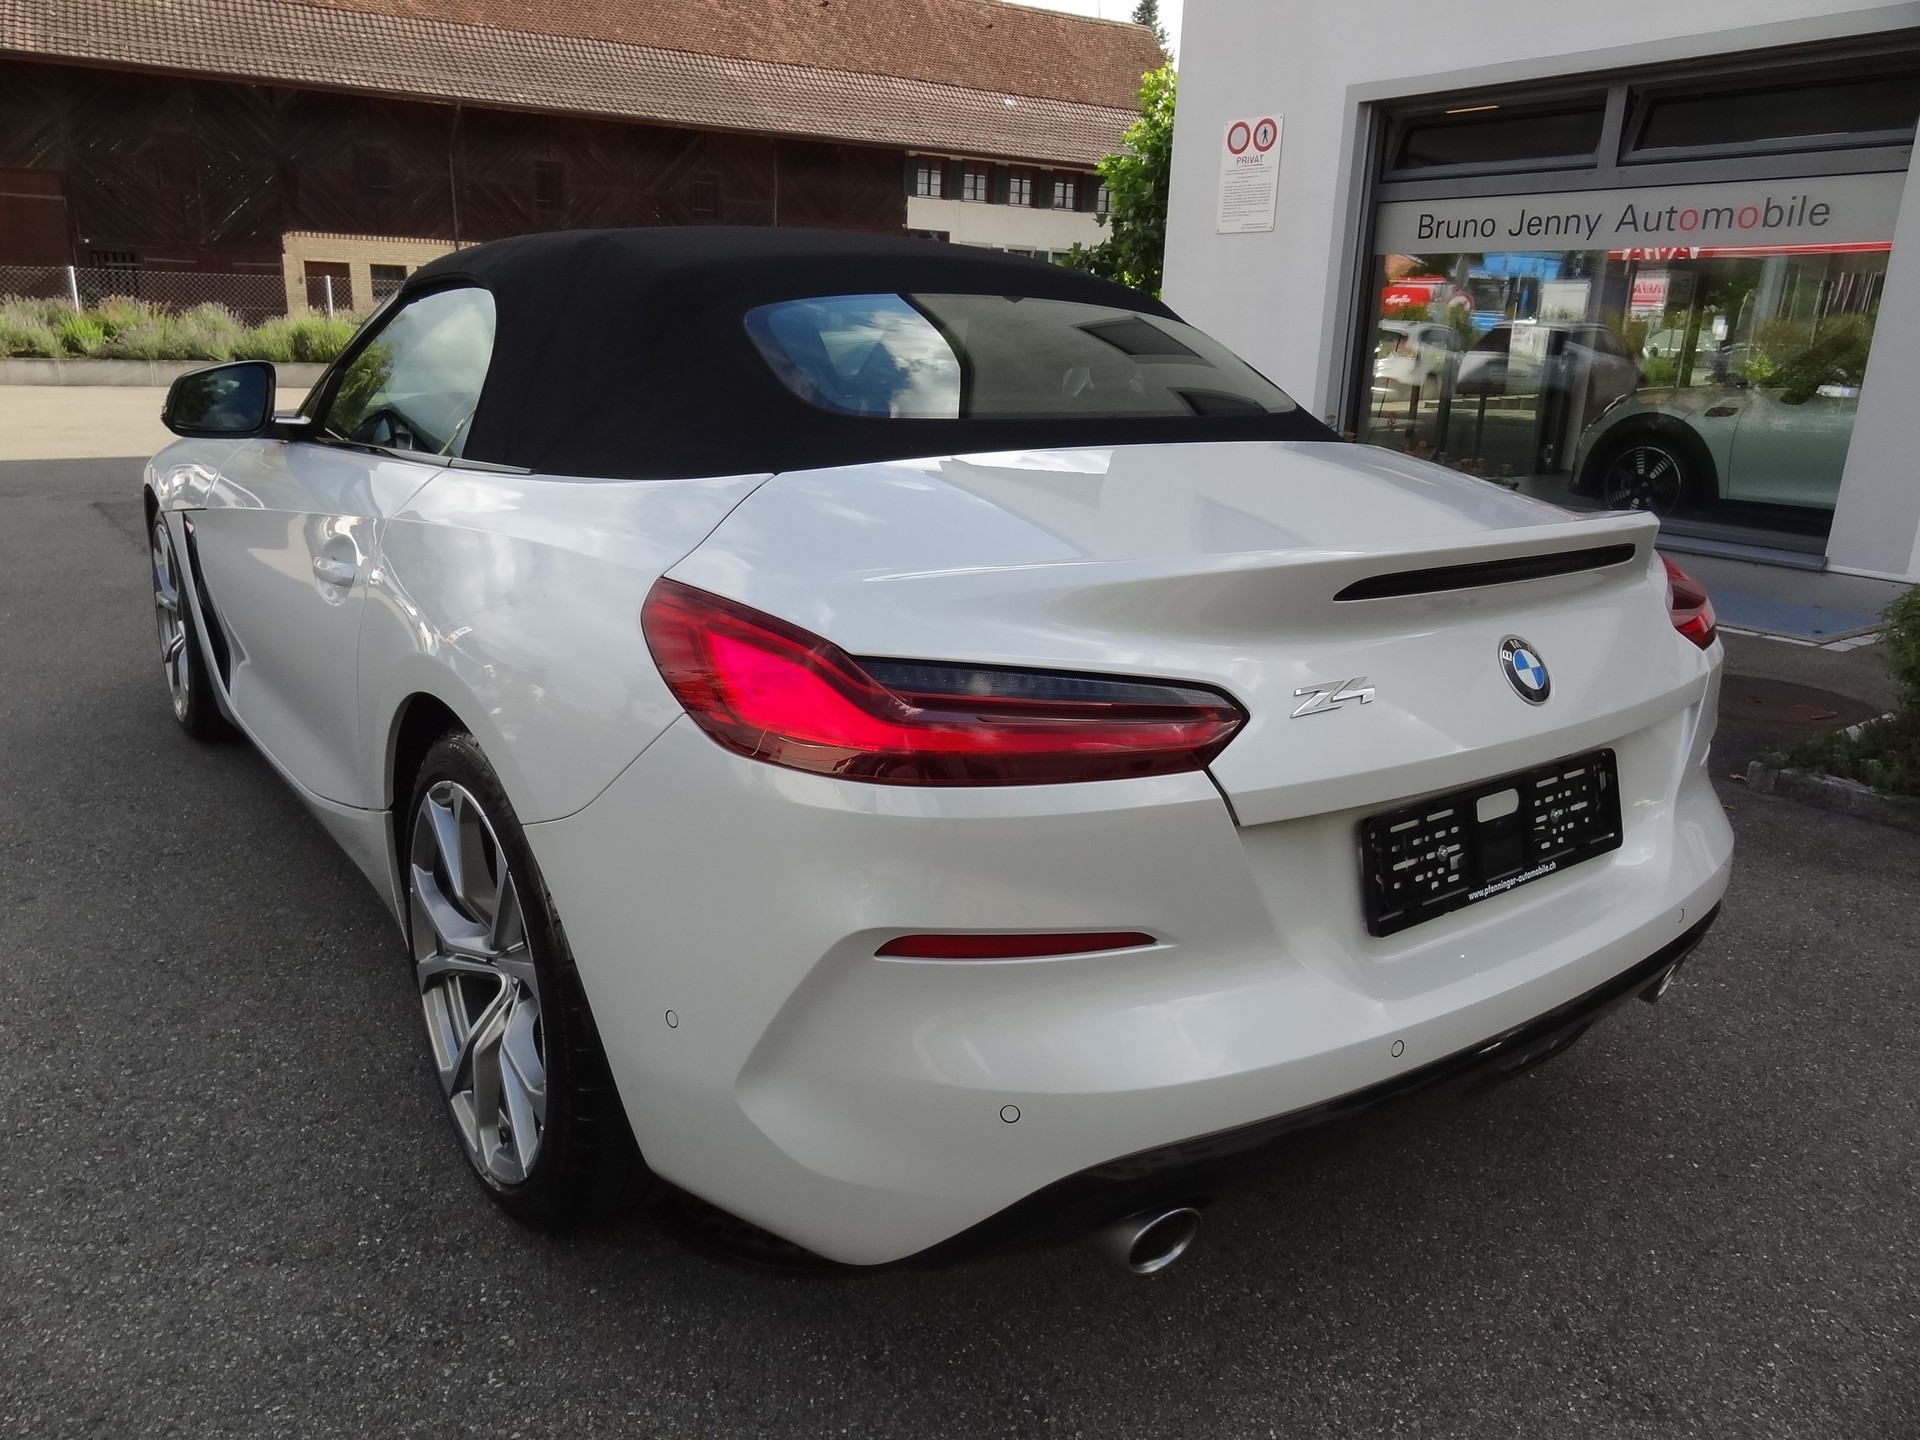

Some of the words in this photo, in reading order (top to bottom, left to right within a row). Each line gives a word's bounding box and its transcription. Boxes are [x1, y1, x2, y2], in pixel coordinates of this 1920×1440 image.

[1236, 154, 1264, 165] PRIVAT
[1418, 213, 1496, 240] Bruno
[1508, 208, 1602, 241] Jenny
[1614, 195, 1831, 233] Automobile
[1468, 861, 1557, 900] www.pfenninger-automobile.ch
